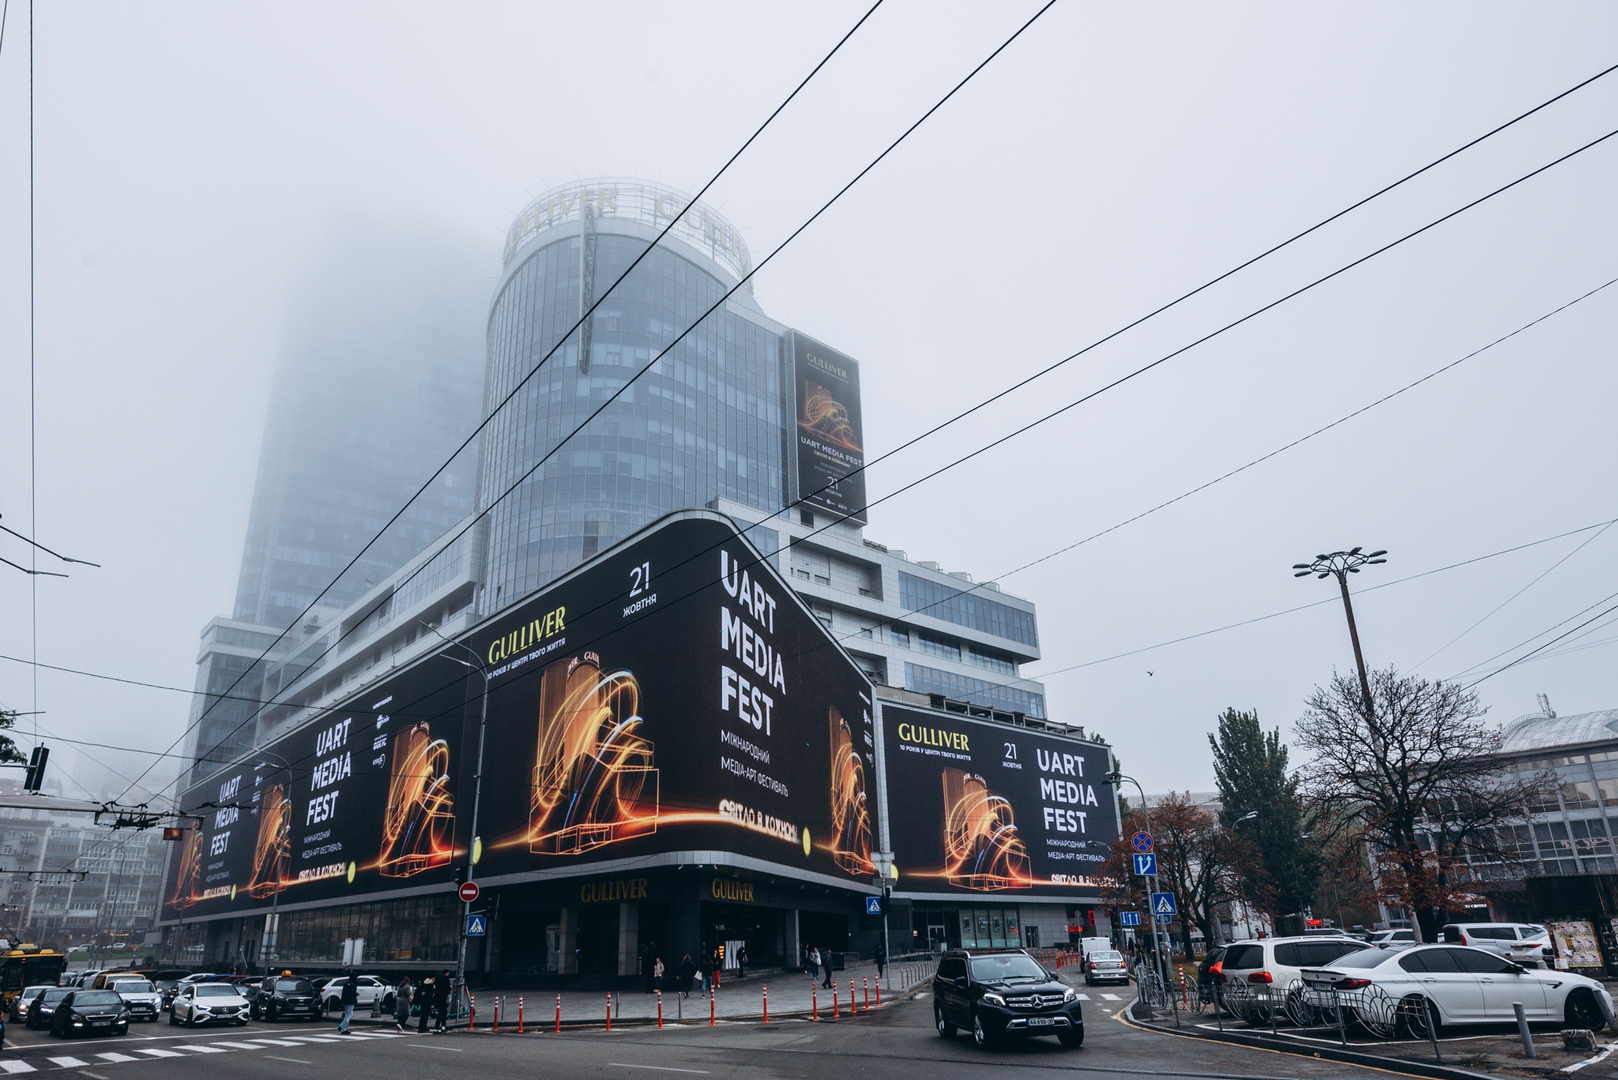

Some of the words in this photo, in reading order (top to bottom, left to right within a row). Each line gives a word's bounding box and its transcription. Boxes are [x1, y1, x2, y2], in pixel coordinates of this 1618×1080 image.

[806, 353, 848, 380] GULLIVER
[800, 436, 821, 449] UART
[822, 444, 844, 460] MEDIA
[845, 454, 862, 467] FEST
[629, 561, 650, 598] 21
[720, 549, 776, 635] UART
[622, 593, 657, 618] ЖОВТНЯ
[488, 606, 566, 665] GULLIVER
[529, 648, 546, 661] ТВОГО
[546, 637, 566, 652] ЖИТТЯ
[720, 606, 786, 696] MEDIA
[720, 665, 774, 737] FEST
[316, 717, 352, 757] UART
[898, 723, 970, 752] GULLIVER
[1004, 742, 1018, 760] 21
[924, 748, 941, 756] ЦЕНТРІ
[941, 751, 956, 759] ТВОГО
[1002, 761, 1022, 770] ЖОВТНЯ
[1036, 748, 1085, 777] UART
[310, 751, 351, 791] MEDIA
[721, 756, 757, 782] МЕДІА-АРТ
[219, 775, 242, 803] UART
[1040, 777, 1099, 807] MEDIA
[214, 802, 239, 830] MEDIA
[306, 790, 339, 826] FEST
[1043, 807, 1087, 834] FEST
[210, 830, 231, 857] FEST
[1046, 838, 1087, 849] МІЖНАРОДНИЙ
[1048, 851, 1075, 860] МЕДІА-АРТ
[1075, 853, 1106, 862] ФЕСТИВАЛЬ
[580, 878, 647, 903] GULLIVER
[712, 877, 754, 902] GULLIVER
